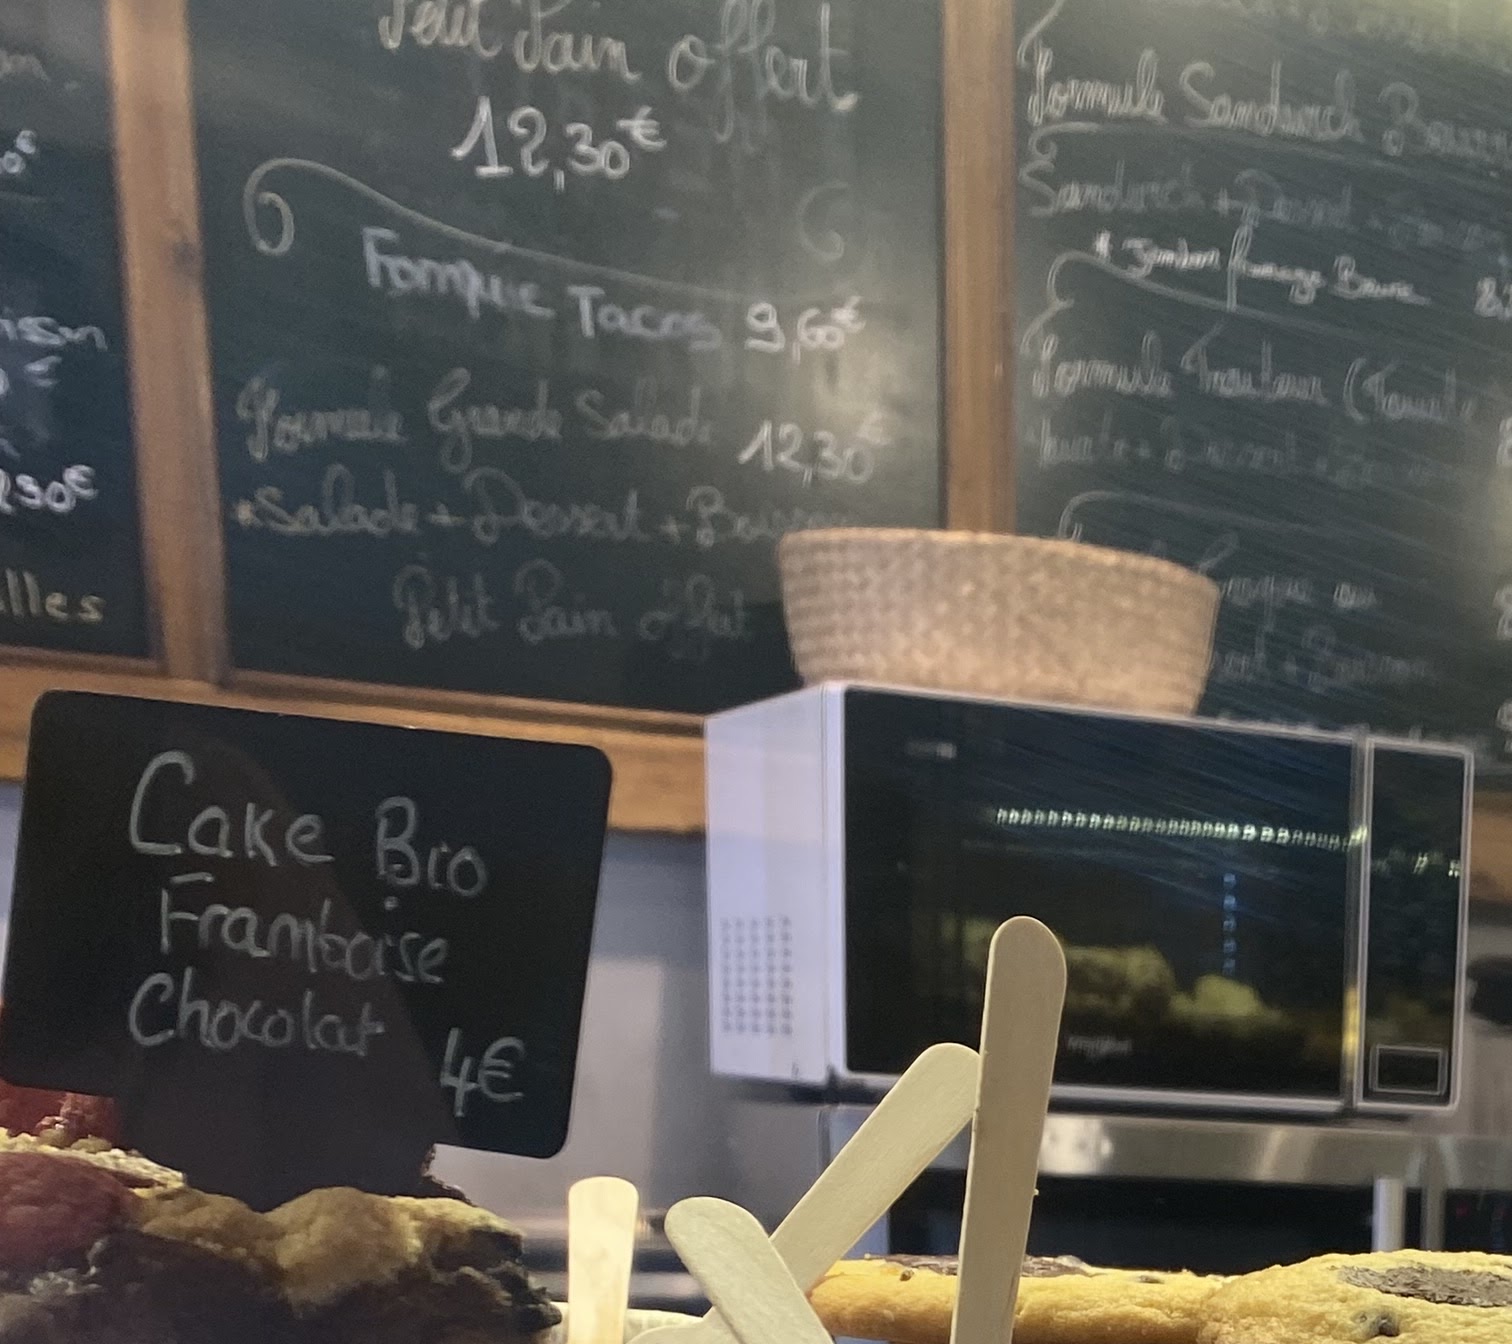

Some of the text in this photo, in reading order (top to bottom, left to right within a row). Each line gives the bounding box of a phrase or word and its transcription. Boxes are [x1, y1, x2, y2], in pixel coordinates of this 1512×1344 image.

[451, 95, 668, 195] 12,30€
[566, 284, 722, 354] Tacos
[130, 749, 487, 899] Cake Bio
[160, 872, 450, 985] Framboise
[128, 966, 386, 1056] Chocolat
[439, 1026, 525, 1118] 4€
